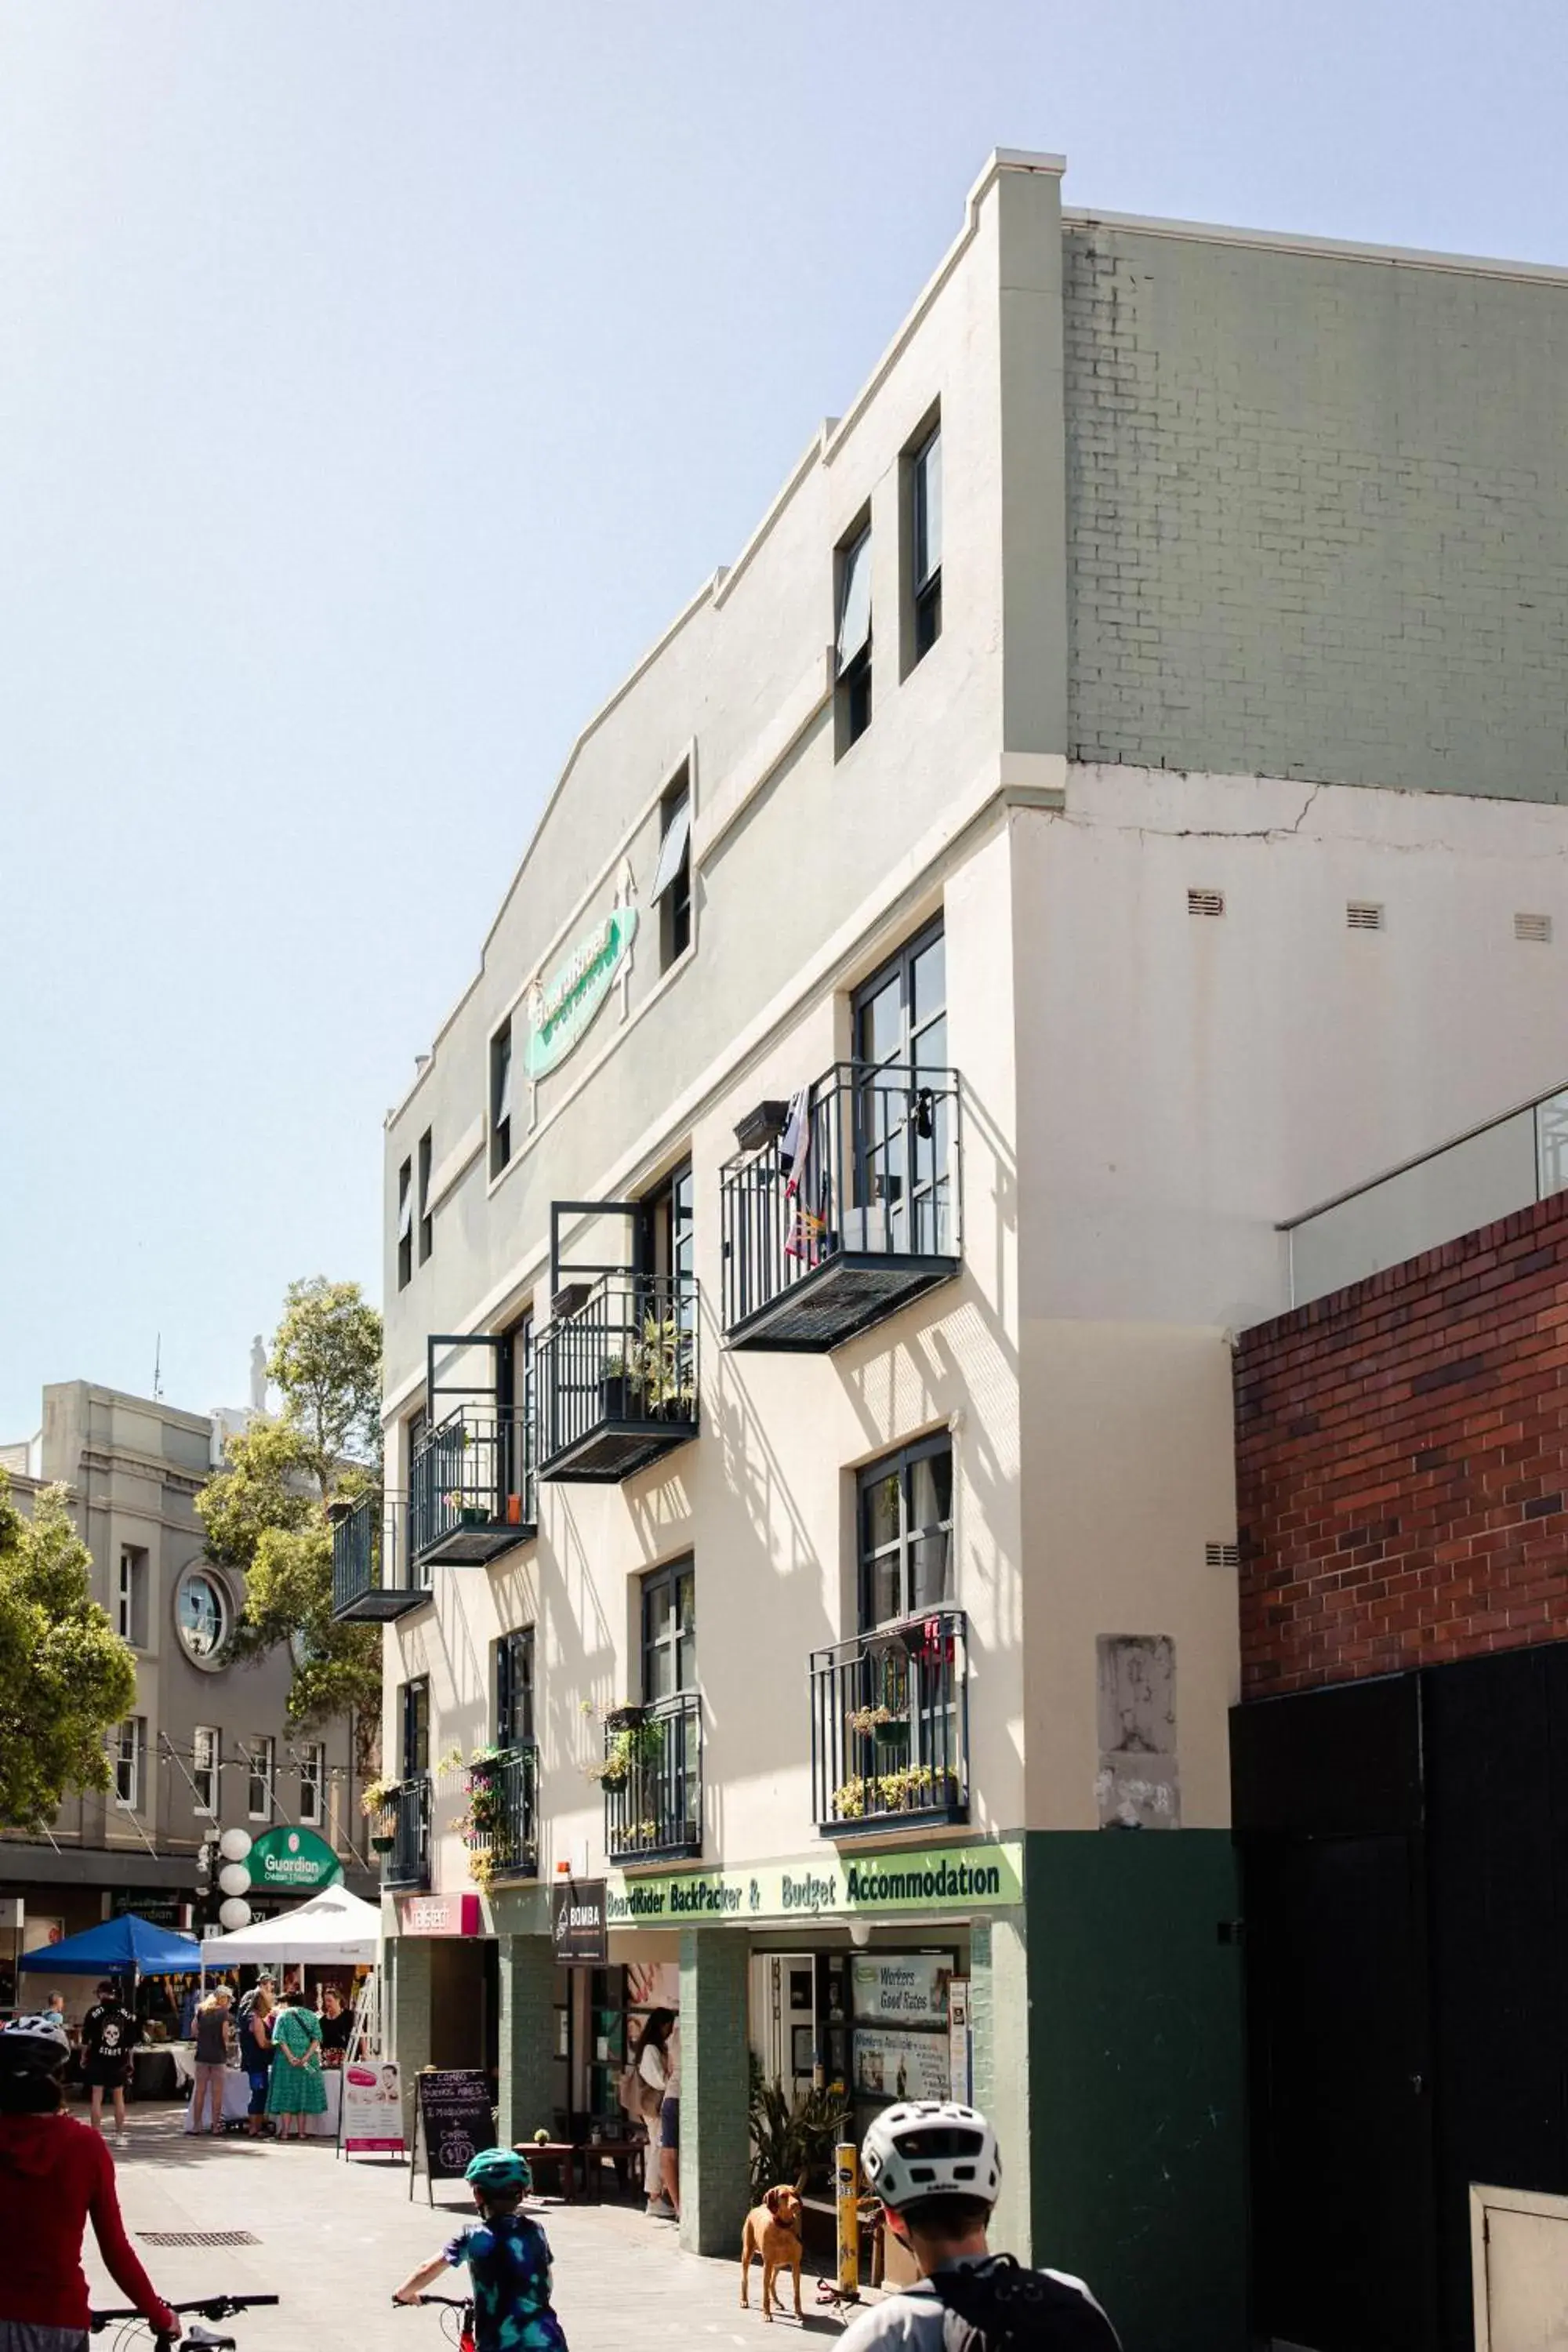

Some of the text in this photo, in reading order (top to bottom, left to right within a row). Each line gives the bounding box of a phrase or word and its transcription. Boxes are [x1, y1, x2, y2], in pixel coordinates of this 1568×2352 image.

[265, 1854, 319, 1873] Guardian
[607, 1887, 666, 1918] BoardRider
[670, 1880, 742, 1913] BackPacker
[782, 1872, 837, 1913] Budget
[847, 1859, 1000, 1902] Accommodation
[570, 1906, 600, 1926] BOMBA
[880, 1966, 915, 1987] Workers
[880, 1991, 927, 2010] Good Rates
